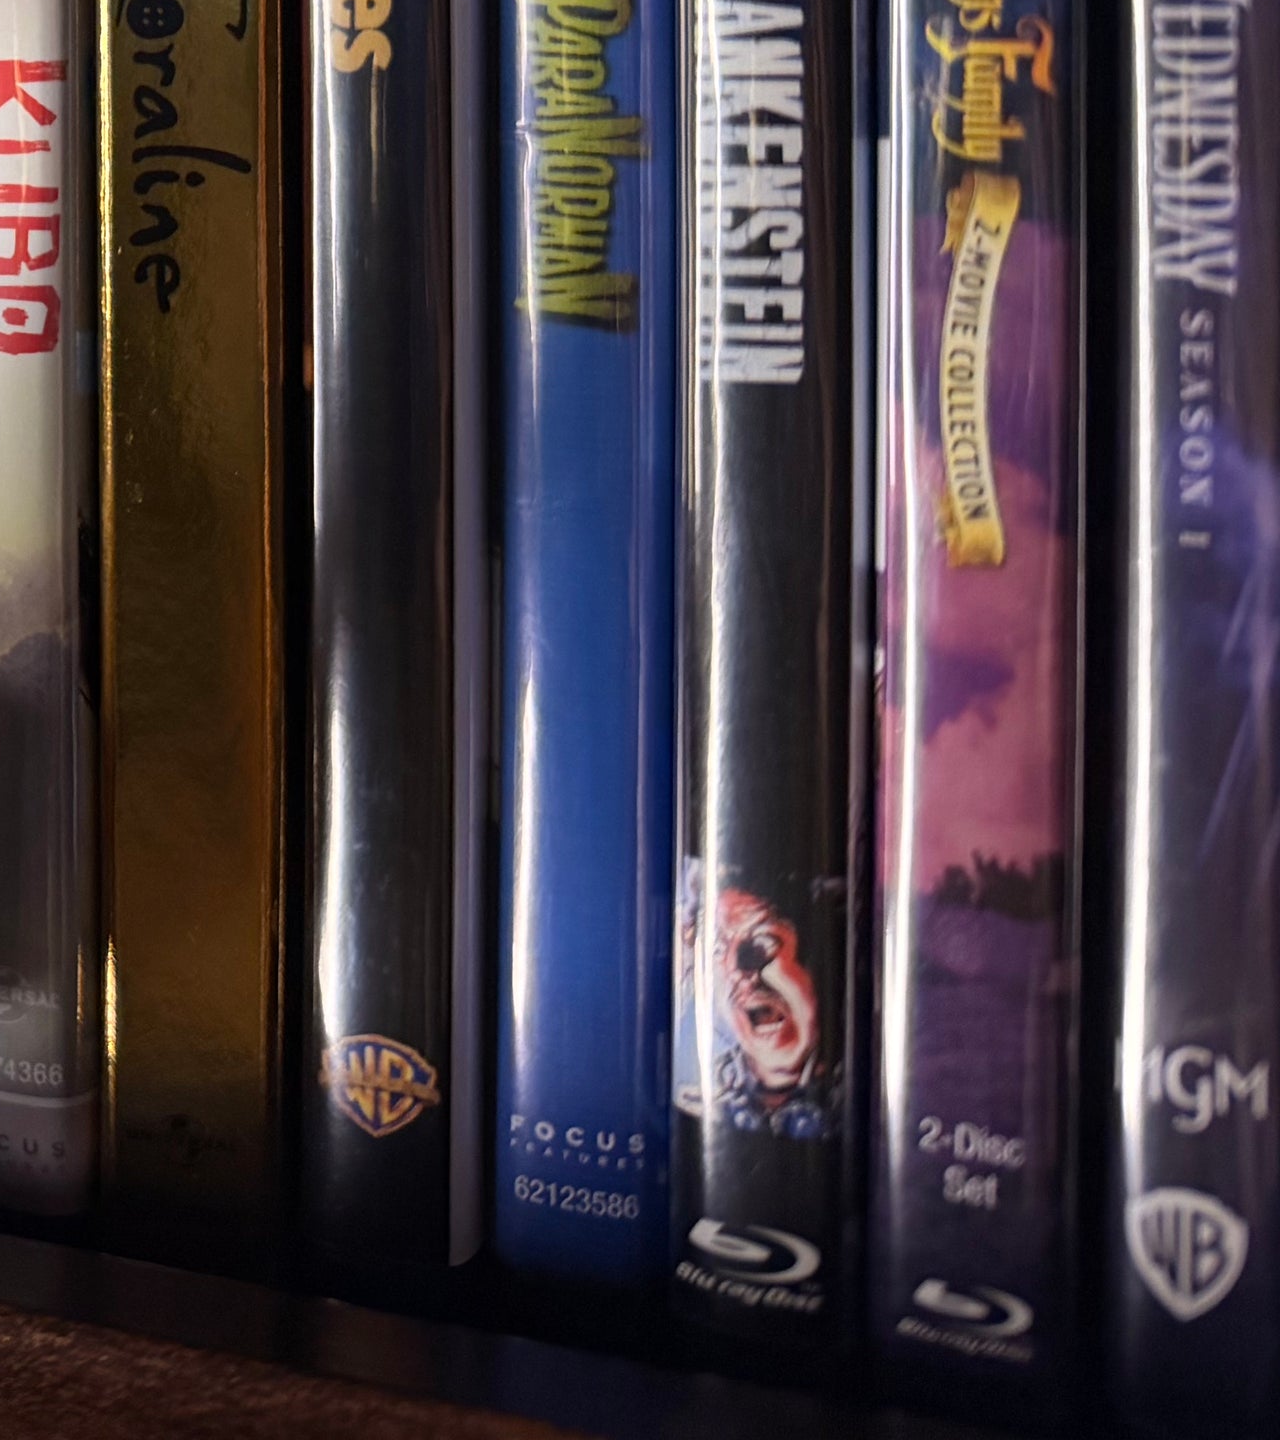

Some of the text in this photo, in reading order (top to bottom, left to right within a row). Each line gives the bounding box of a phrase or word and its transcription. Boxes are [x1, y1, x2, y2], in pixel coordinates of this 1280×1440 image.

[925, 17, 1056, 163] Family
[947, 219, 1003, 523] 2-MOVIE COLLECTION
[1178, 307, 1214, 510] SEASON
[509, 1114, 647, 1155] FOCUS
[917, 1116, 1028, 1169] 2-Disc
[513, 1173, 642, 1221] 62123586
[942, 1167, 1000, 1211] Set
